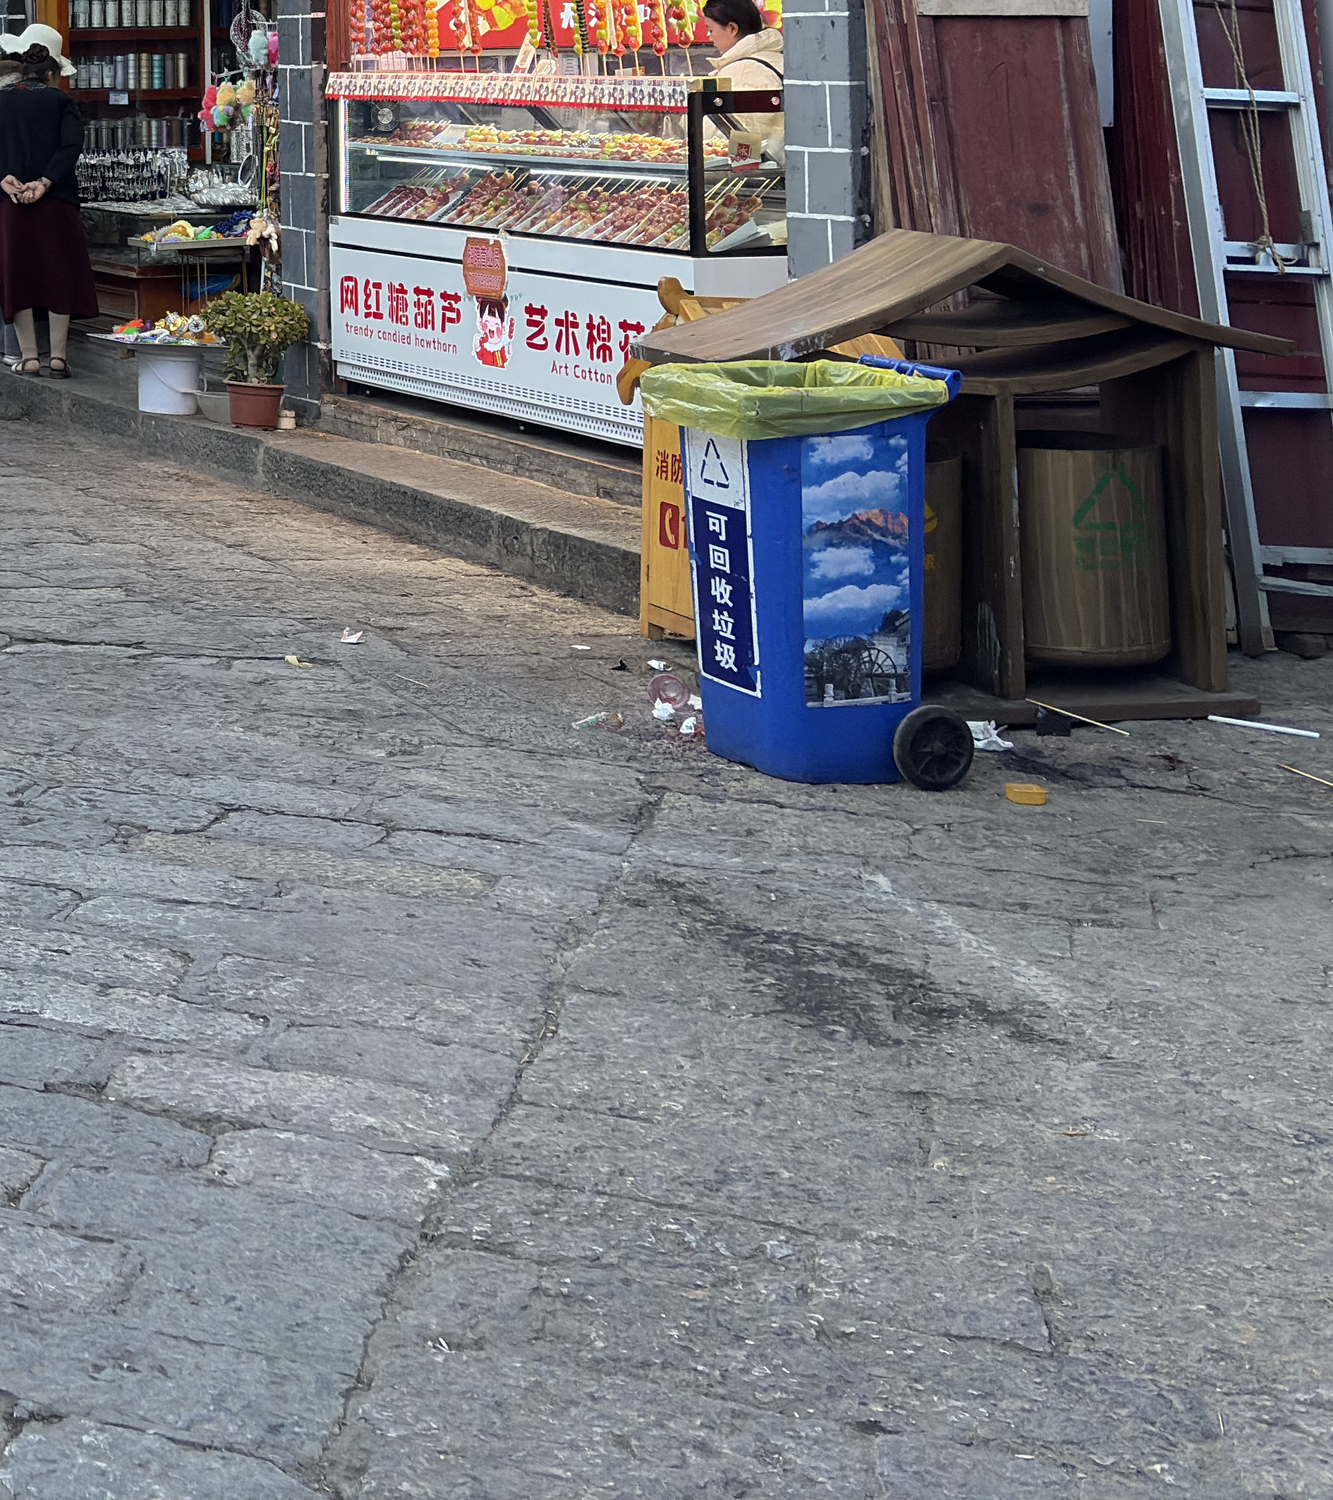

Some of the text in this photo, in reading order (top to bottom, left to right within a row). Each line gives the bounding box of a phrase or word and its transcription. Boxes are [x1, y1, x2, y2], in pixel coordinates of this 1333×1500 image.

[340, 275, 462, 334] 网红糖葫芦
[345, 321, 458, 354] trendy candied hawthorn
[551, 360, 613, 385] Art Cotton
[705, 511, 738, 673] 可回收垃圾
